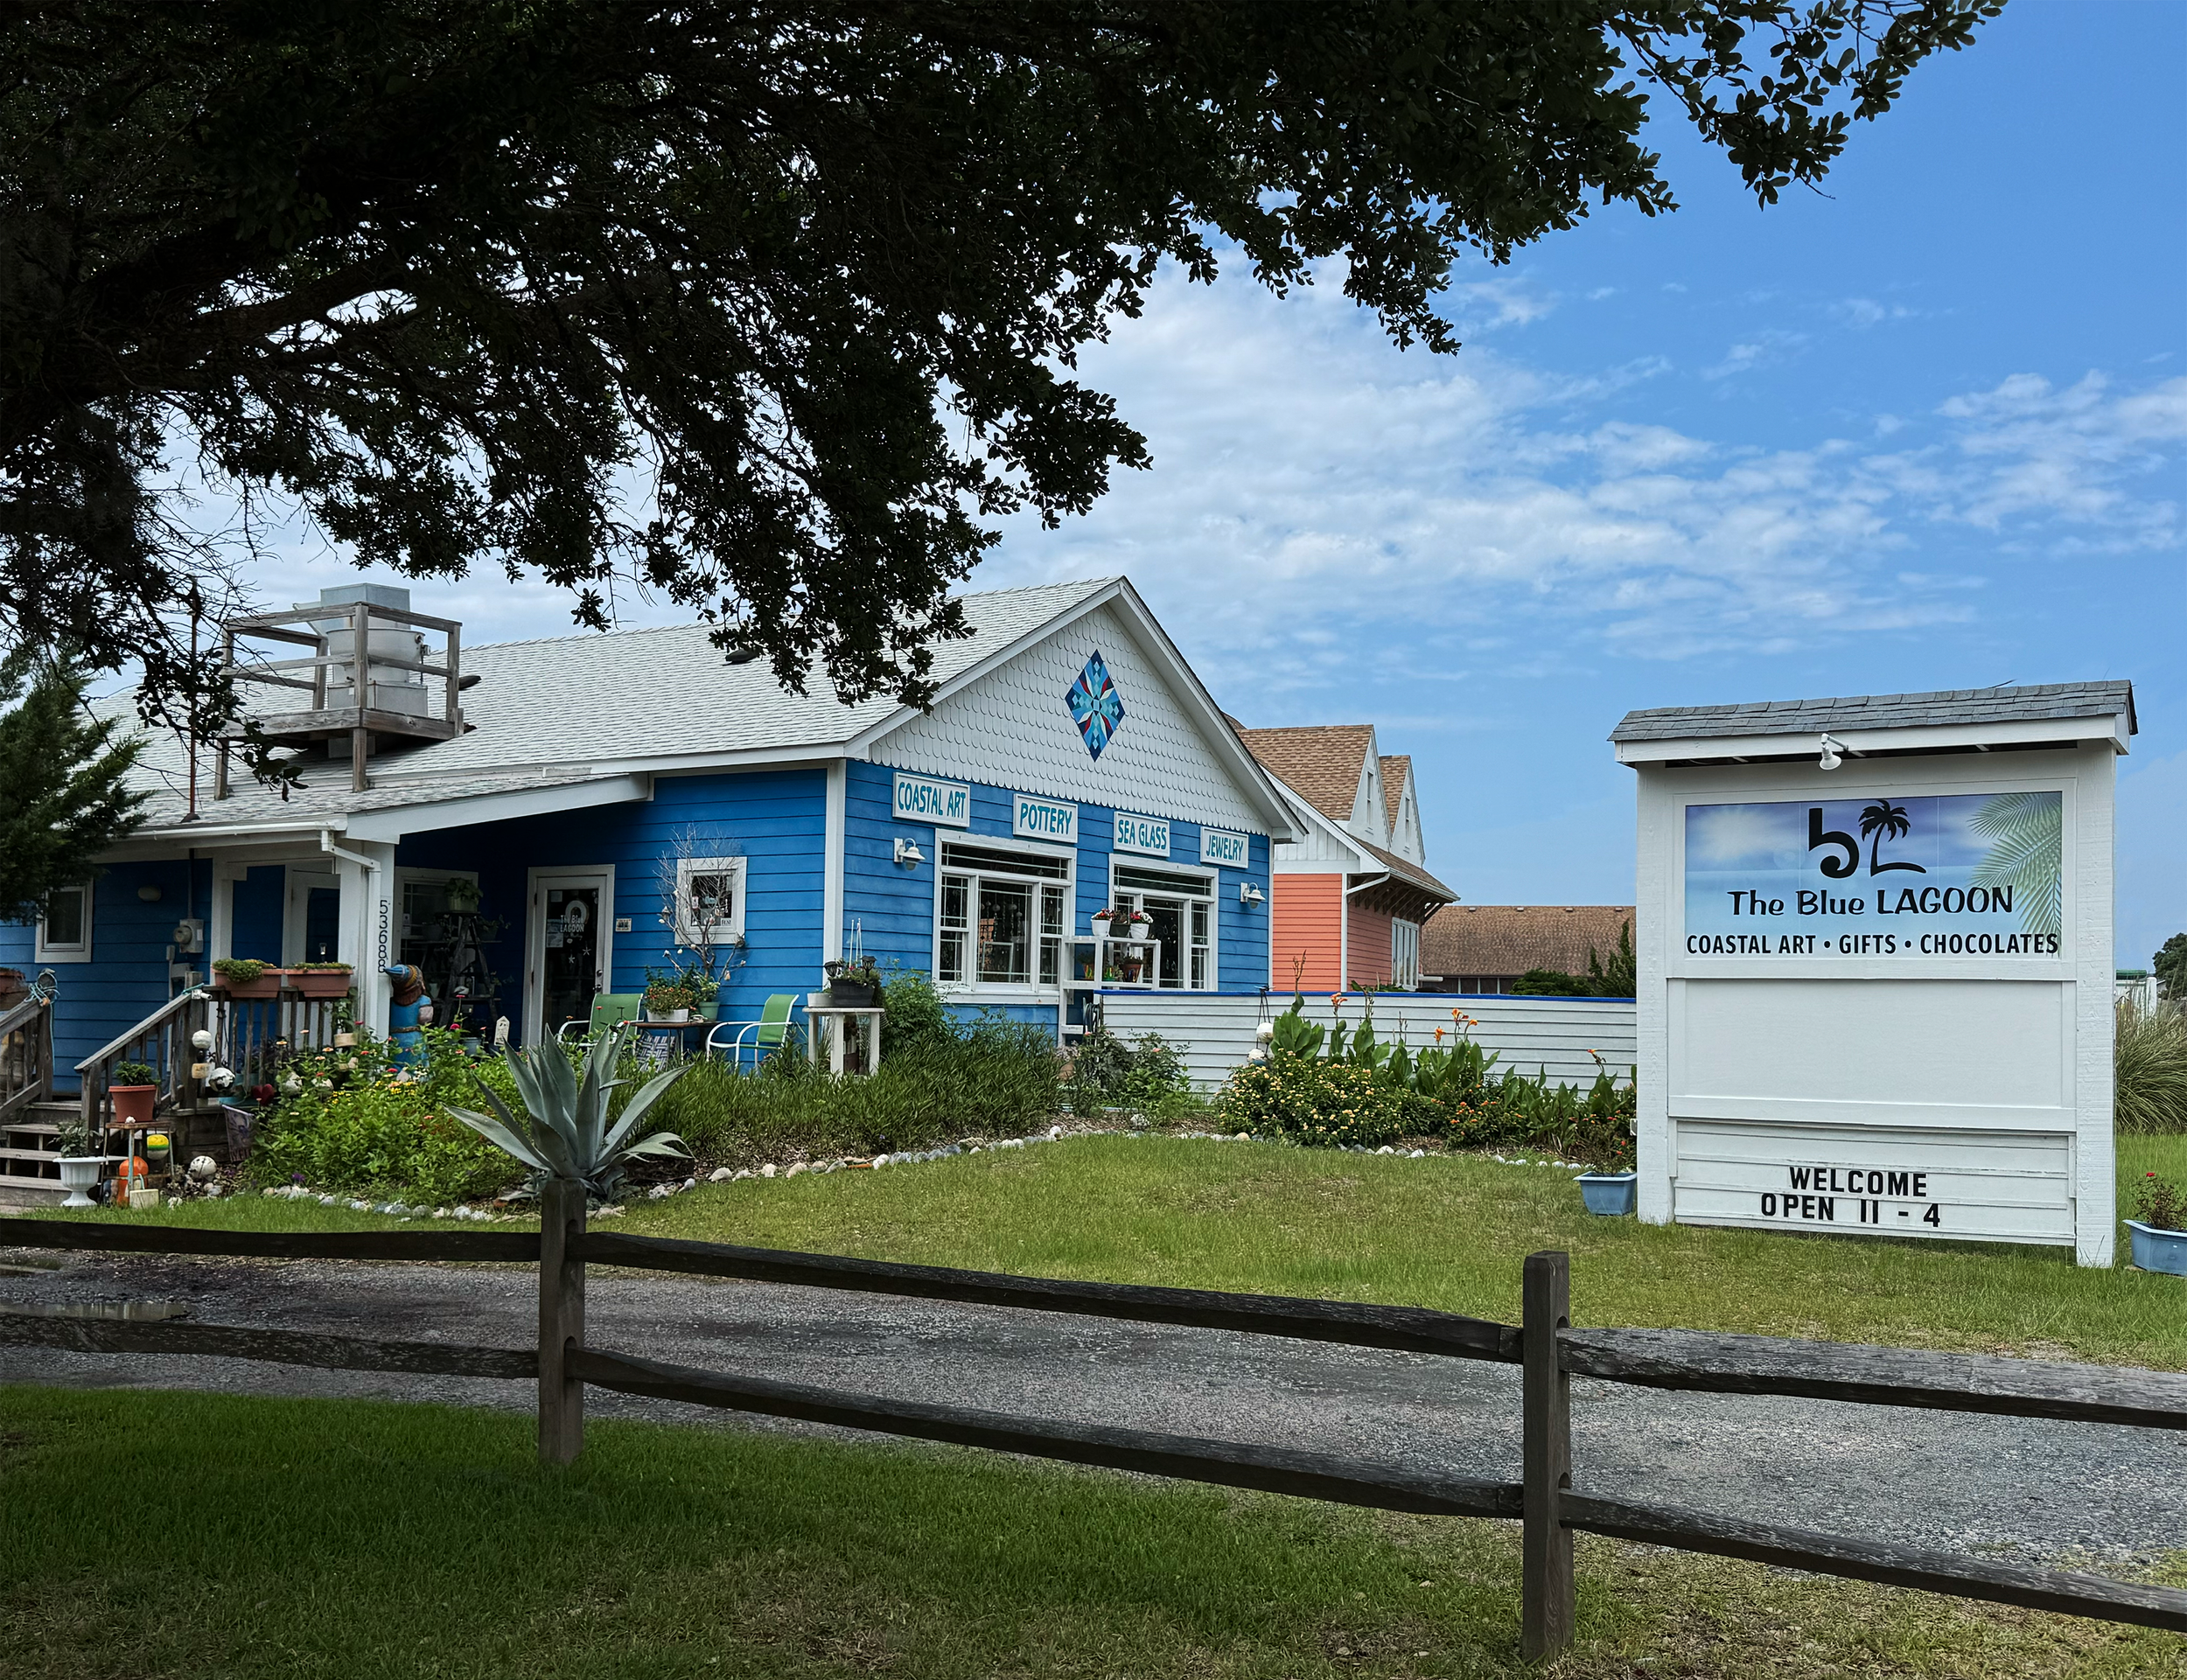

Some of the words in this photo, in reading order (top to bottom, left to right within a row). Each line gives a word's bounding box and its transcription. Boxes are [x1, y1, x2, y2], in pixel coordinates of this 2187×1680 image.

[898, 781, 943, 816] COASTAL
[947, 790, 966, 819] ART
[1019, 802, 1073, 834] POTTERY
[1117, 819, 1135, 846] SEA
[1138, 822, 1167, 850] GLASS
[1205, 834, 1244, 861] JEWELRY
[1727, 889, 1785, 916] The
[1796, 889, 1865, 916] Blue
[1876, 885, 2013, 915] LAGOON
[377, 899, 389, 973] 53688
[560, 924, 585, 933] LAGOON
[1687, 934, 1771, 954] COASTAL
[1778, 935, 1816, 954] ART
[1839, 934, 1897, 954] GIFTS
[1920, 933, 2059, 954] CHOCOLATES
[1789, 1166, 1927, 1197] WELCOME
[1761, 1192, 1834, 1221] OPEN
[1923, 1202, 1940, 1228] 4
